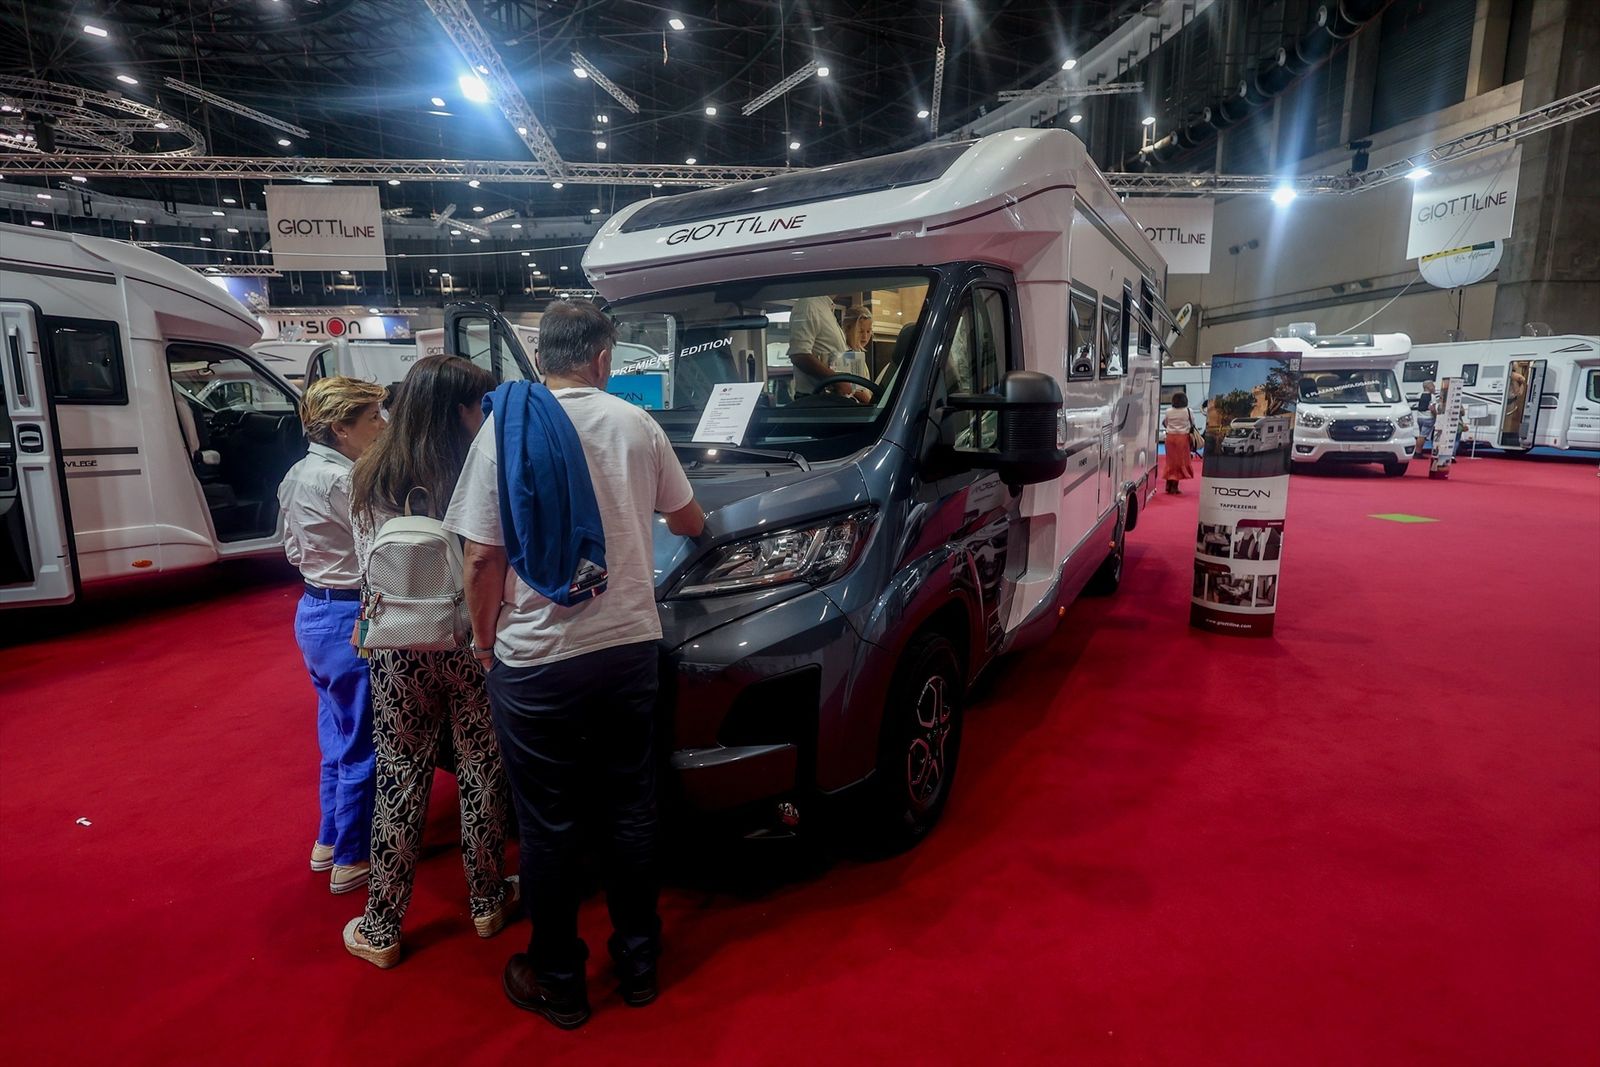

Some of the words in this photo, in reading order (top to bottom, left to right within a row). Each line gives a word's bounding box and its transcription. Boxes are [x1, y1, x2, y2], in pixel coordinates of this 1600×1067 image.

[277, 219, 375, 238] GIOTTILINE
[666, 214, 807, 246] GIOTTILINE
[1144, 227, 1206, 244] OTTILINE
[680, 336, 733, 358] EDITION
[1310, 387, 1334, 397] PLAZAS
[1211, 486, 1271, 498] TOSCAN
